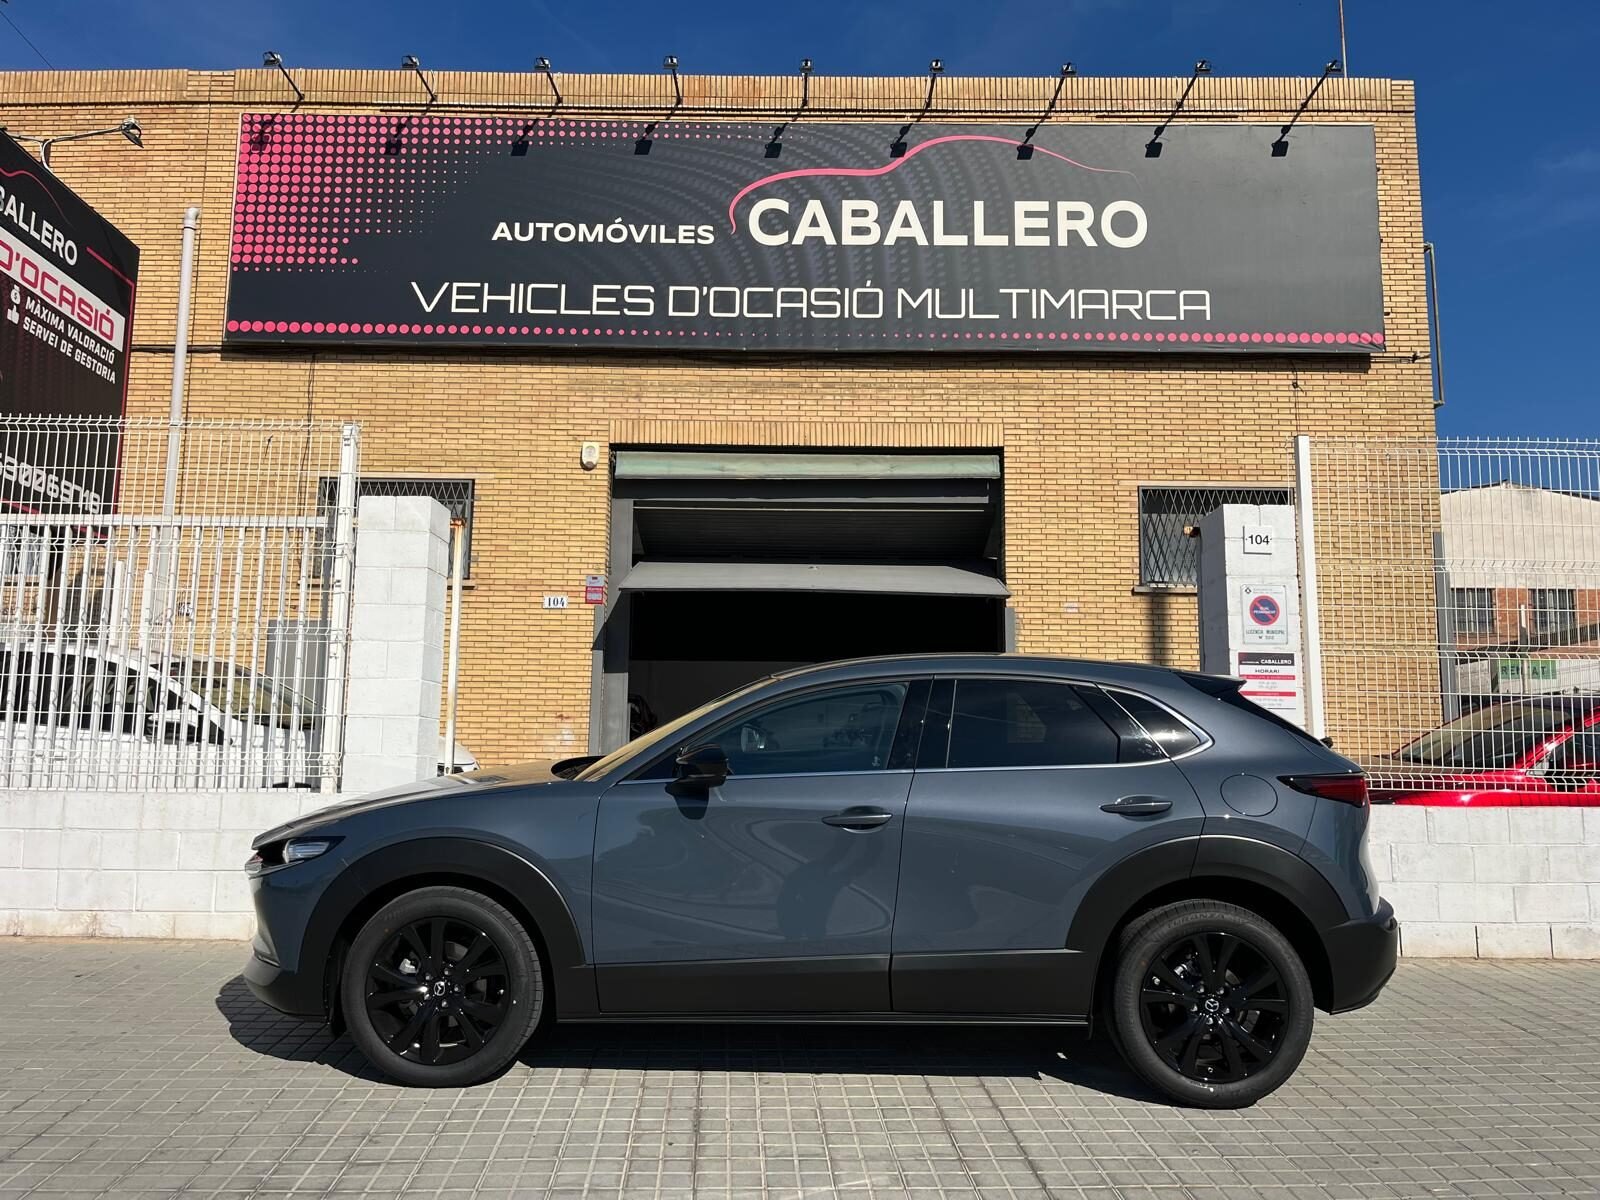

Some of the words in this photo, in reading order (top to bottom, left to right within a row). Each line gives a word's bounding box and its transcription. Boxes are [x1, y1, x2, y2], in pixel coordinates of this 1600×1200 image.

[492, 217, 715, 245] AUTOMÓVILES
[748, 198, 1148, 249] CABALLERO
[411, 281, 655, 316] VEHICLES
[668, 280, 884, 319] D'OCASIÓ
[897, 288, 1211, 322] MULTIMARCA
[22, 316, 59, 348] SERVEI
[59, 339, 74, 358] DE
[74, 348, 117, 385] GESTORIA
[25, 296, 65, 333] MÀXIMA
[67, 323, 115, 365] VALORACIÓ
[0, 452, 101, 514] 30069718
[1248, 534, 1270, 545] 104
[548, 597, 565, 607] 104
